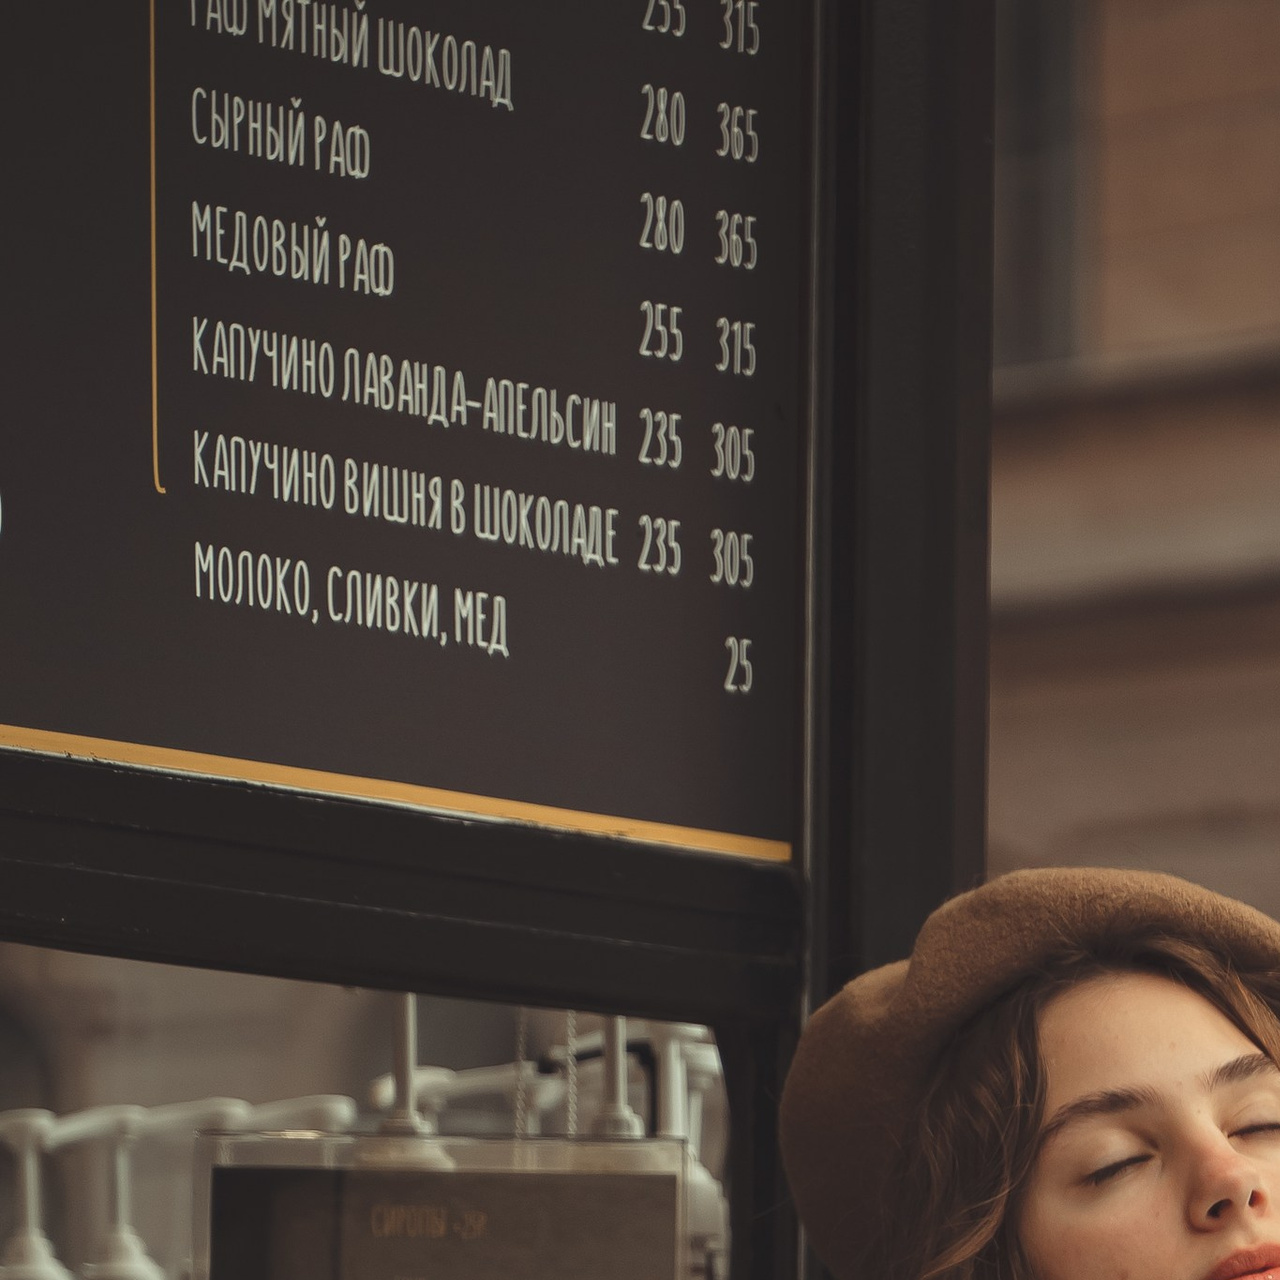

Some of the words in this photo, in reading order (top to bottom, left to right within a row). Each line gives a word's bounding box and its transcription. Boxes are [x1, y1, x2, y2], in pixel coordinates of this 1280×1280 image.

[258, 0, 368, 67] МЯТНЫЙ
[378, 18, 514, 111] ШОКОЛАД
[641, 84, 685, 146] 280
[717, 103, 758, 162] 365
[720, 0, 759, 55] 315
[192, 87, 304, 166] СЫРНЫЙ
[315, 116, 369, 179] РАФ
[640, 193, 684, 254] 280
[715, 210, 757, 269] 365
[192, 201, 329, 284] МЕДОВЫЙ
[339, 234, 394, 296] РАФ
[639, 300, 683, 361] 255
[716, 317, 756, 376] 315
[193, 316, 334, 398] КАПУЧИНО
[342, 348, 616, 455] ЛАВАНДА-АПЕЛЬСИН
[638, 408, 682, 468] 235
[711, 423, 754, 481] 305
[194, 430, 335, 509] КАПУЧИНО
[344, 458, 442, 529] ВИШНЯ
[451, 479, 465, 534] В
[474, 484, 618, 567] ШОКОЛАДЕ
[638, 515, 681, 575] 235
[710, 529, 753, 587] 305
[195, 541, 318, 624] МОЛОКО,
[327, 566, 447, 646] СЛИВКИ,
[455, 588, 509, 657] МЕД
[724, 636, 752, 692] 25
